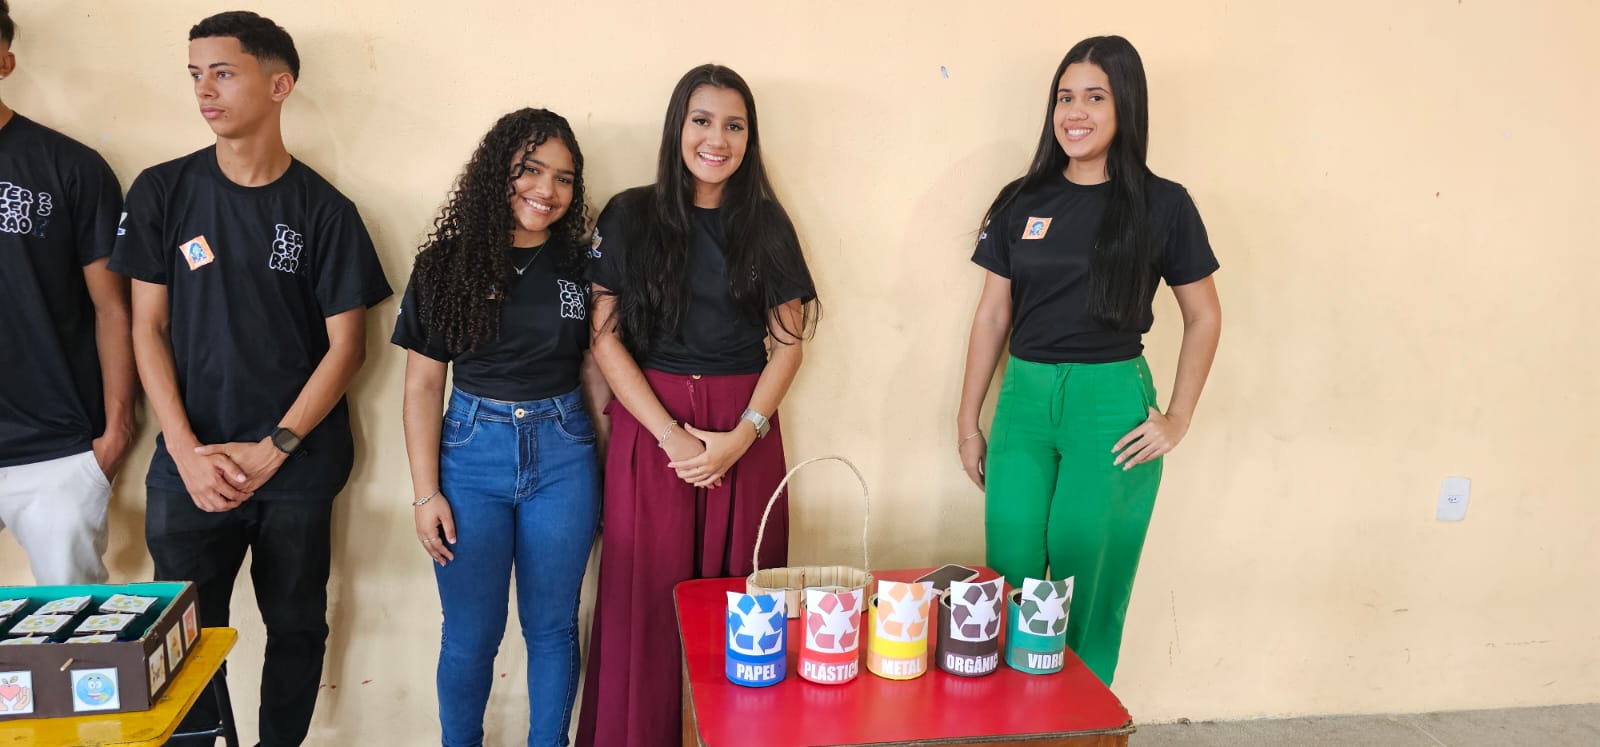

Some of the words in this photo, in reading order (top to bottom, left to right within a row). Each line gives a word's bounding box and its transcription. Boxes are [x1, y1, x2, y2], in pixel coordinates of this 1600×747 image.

[0, 181, 33, 203] TER
[275, 223, 304, 248] TER
[272, 239, 302, 260] CEI
[560, 290, 585, 306] CEI
[560, 302, 586, 320] RÃO
[736, 663, 777, 681] PAPEL
[881, 657, 922, 676] METAL
